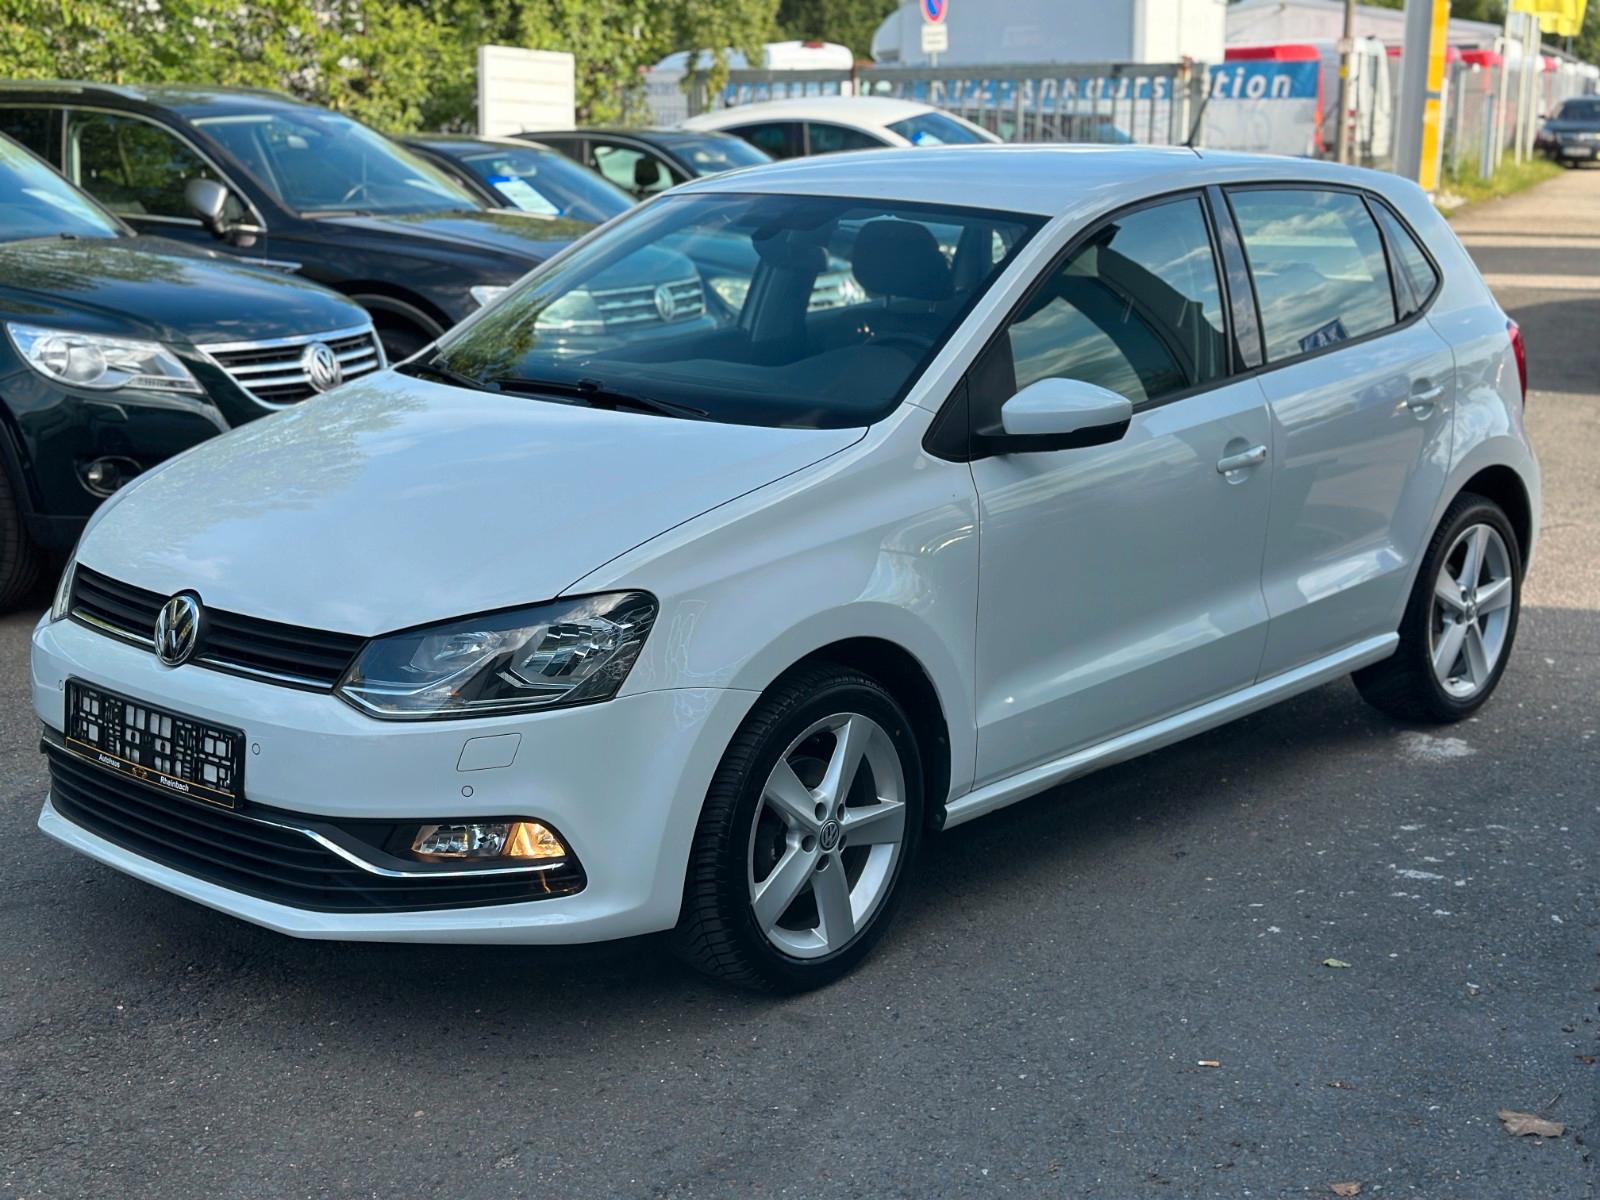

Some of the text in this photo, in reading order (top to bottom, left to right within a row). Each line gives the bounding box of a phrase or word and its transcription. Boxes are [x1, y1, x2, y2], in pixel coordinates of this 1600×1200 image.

[155, 596, 199, 665] VW
[98, 755, 189, 792] Autohaus Rheinbach
